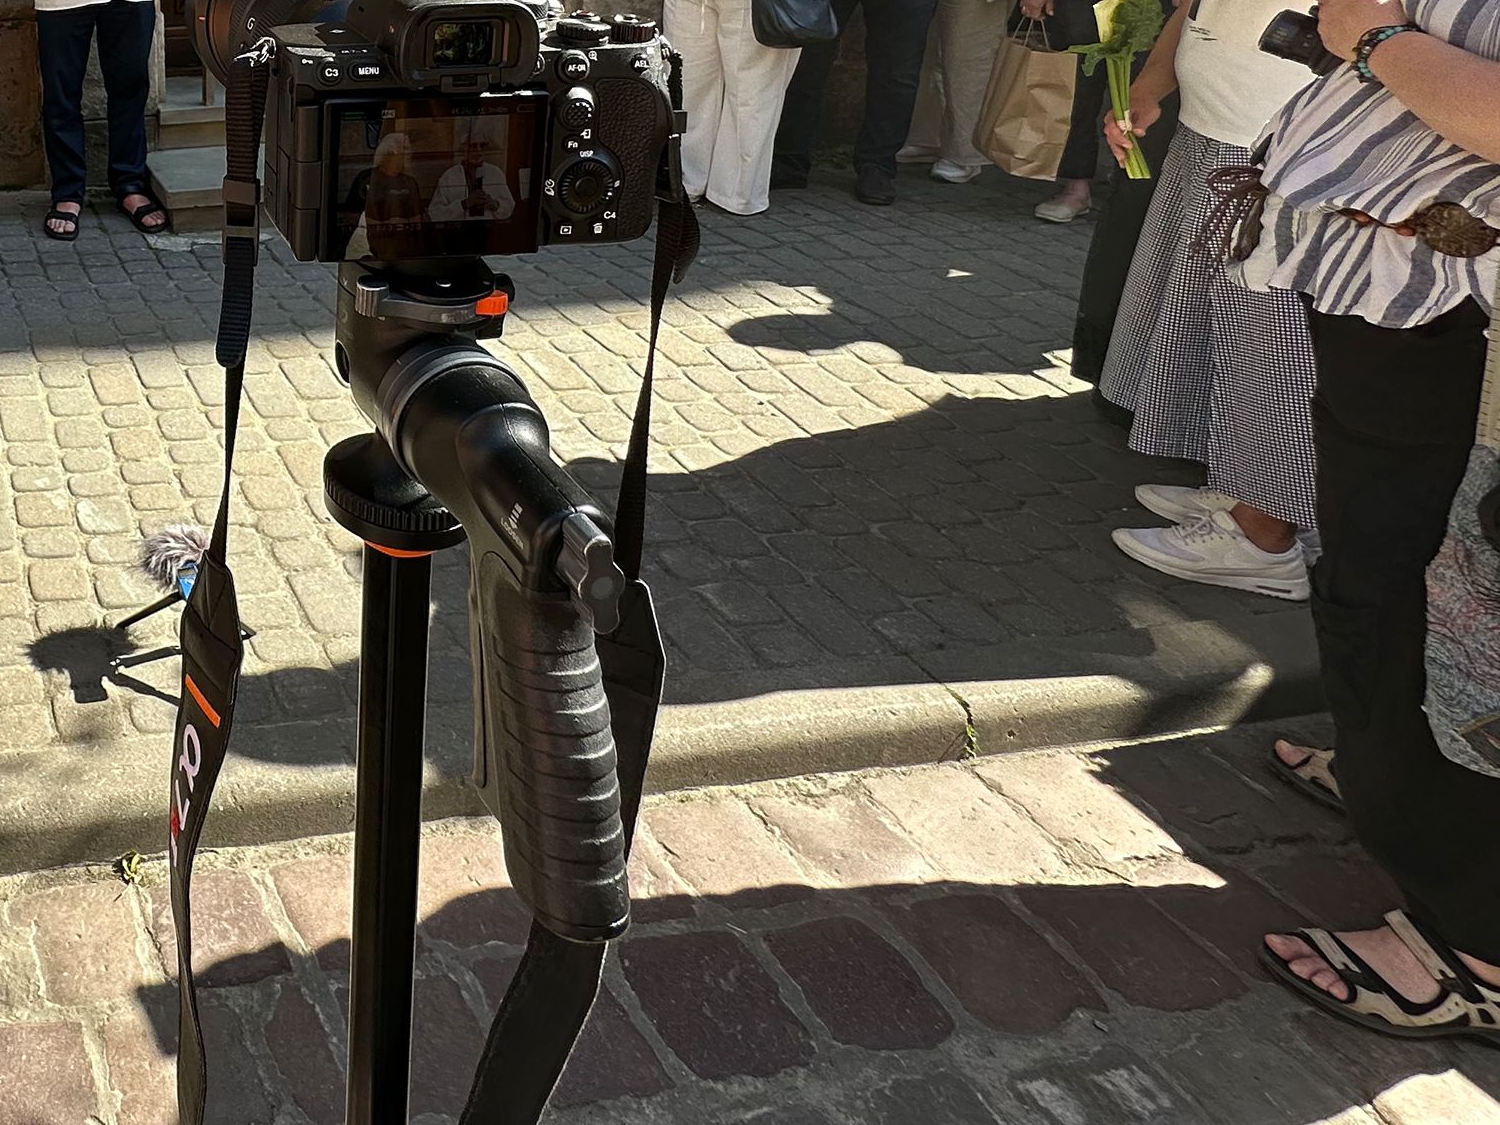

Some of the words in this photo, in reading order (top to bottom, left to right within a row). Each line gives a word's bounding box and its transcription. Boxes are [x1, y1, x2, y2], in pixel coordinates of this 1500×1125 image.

[324, 68, 340, 78] C3
[358, 66, 380, 76] MENU
[567, 140, 579, 149] Fn
[603, 210, 617, 219] C4
